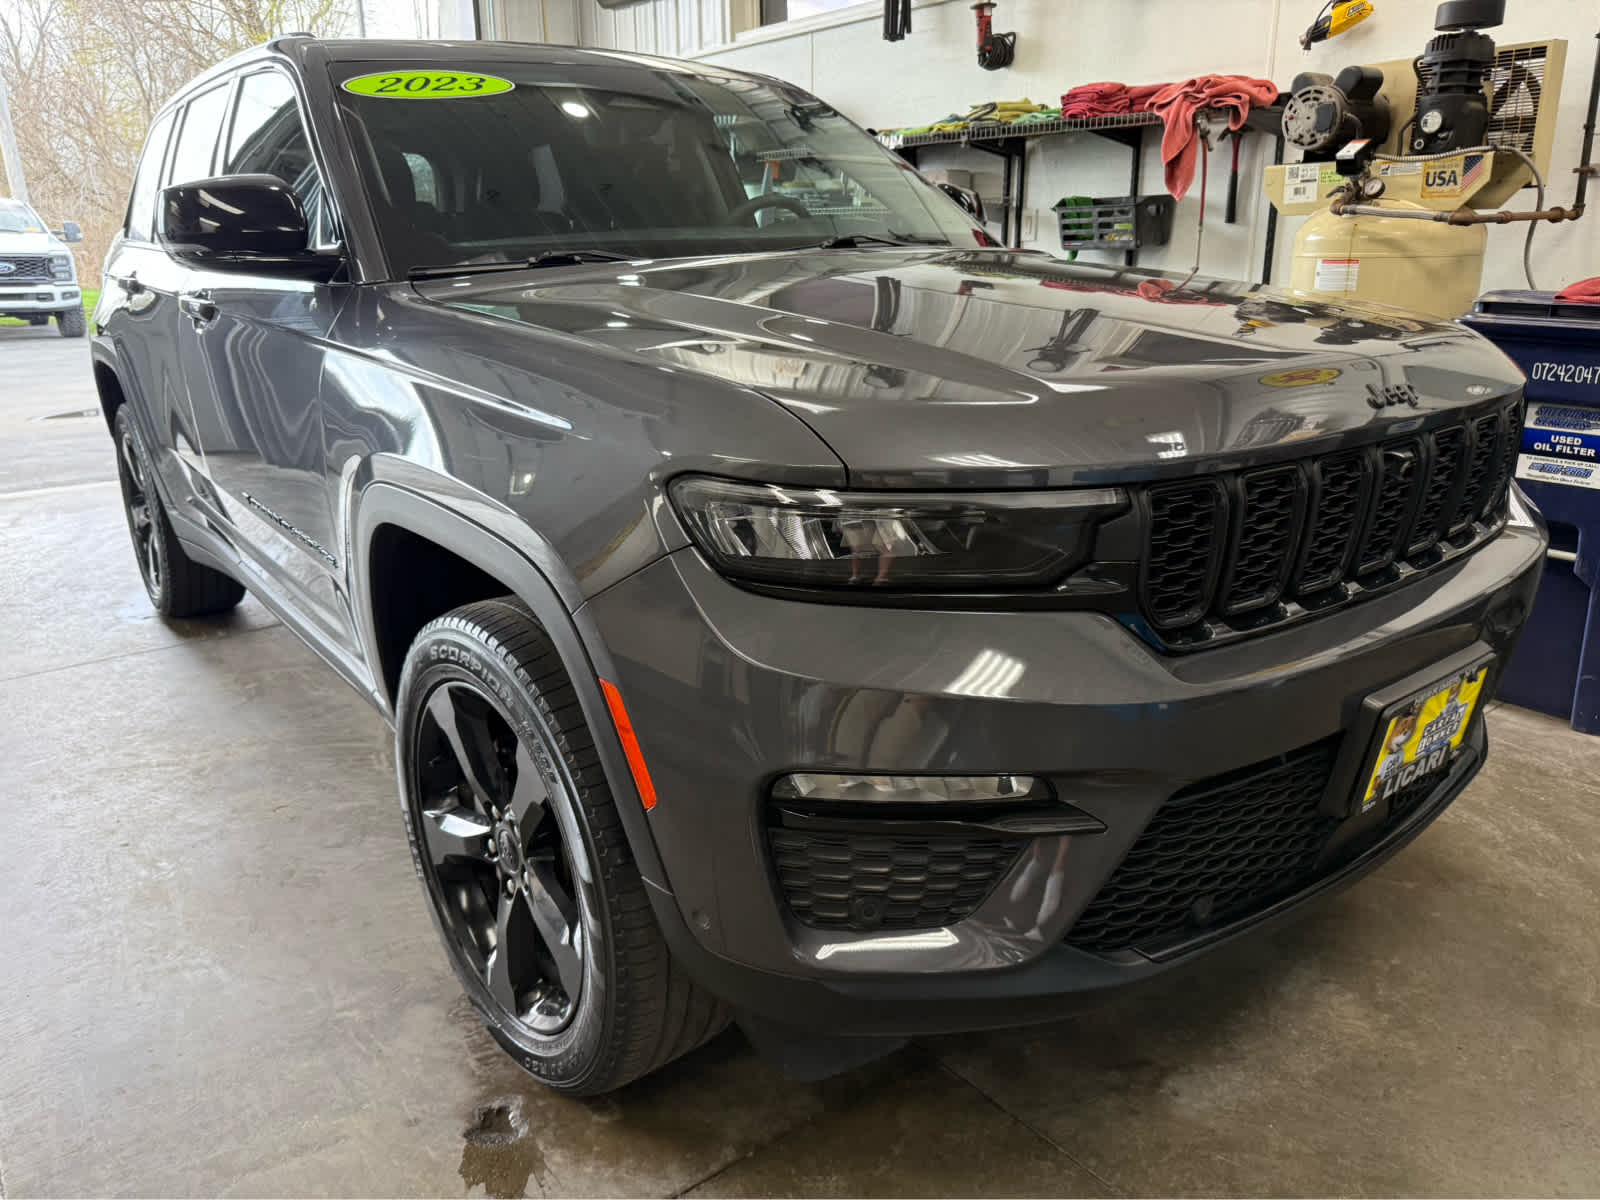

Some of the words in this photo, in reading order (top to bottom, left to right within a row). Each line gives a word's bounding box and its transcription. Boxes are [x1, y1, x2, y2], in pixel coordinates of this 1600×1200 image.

[374, 76, 486, 93] 2023
[1425, 170, 1458, 187] USA
[1532, 362, 1600, 385] 07242047
[1366, 384, 1418, 409] Jeep
[1533, 442, 1553, 452] OIL
[1555, 444, 1597, 457] FILTER
[1551, 435, 1582, 446] USED
[430, 645, 514, 709] SCORPION
[1383, 744, 1448, 800] LICARI
